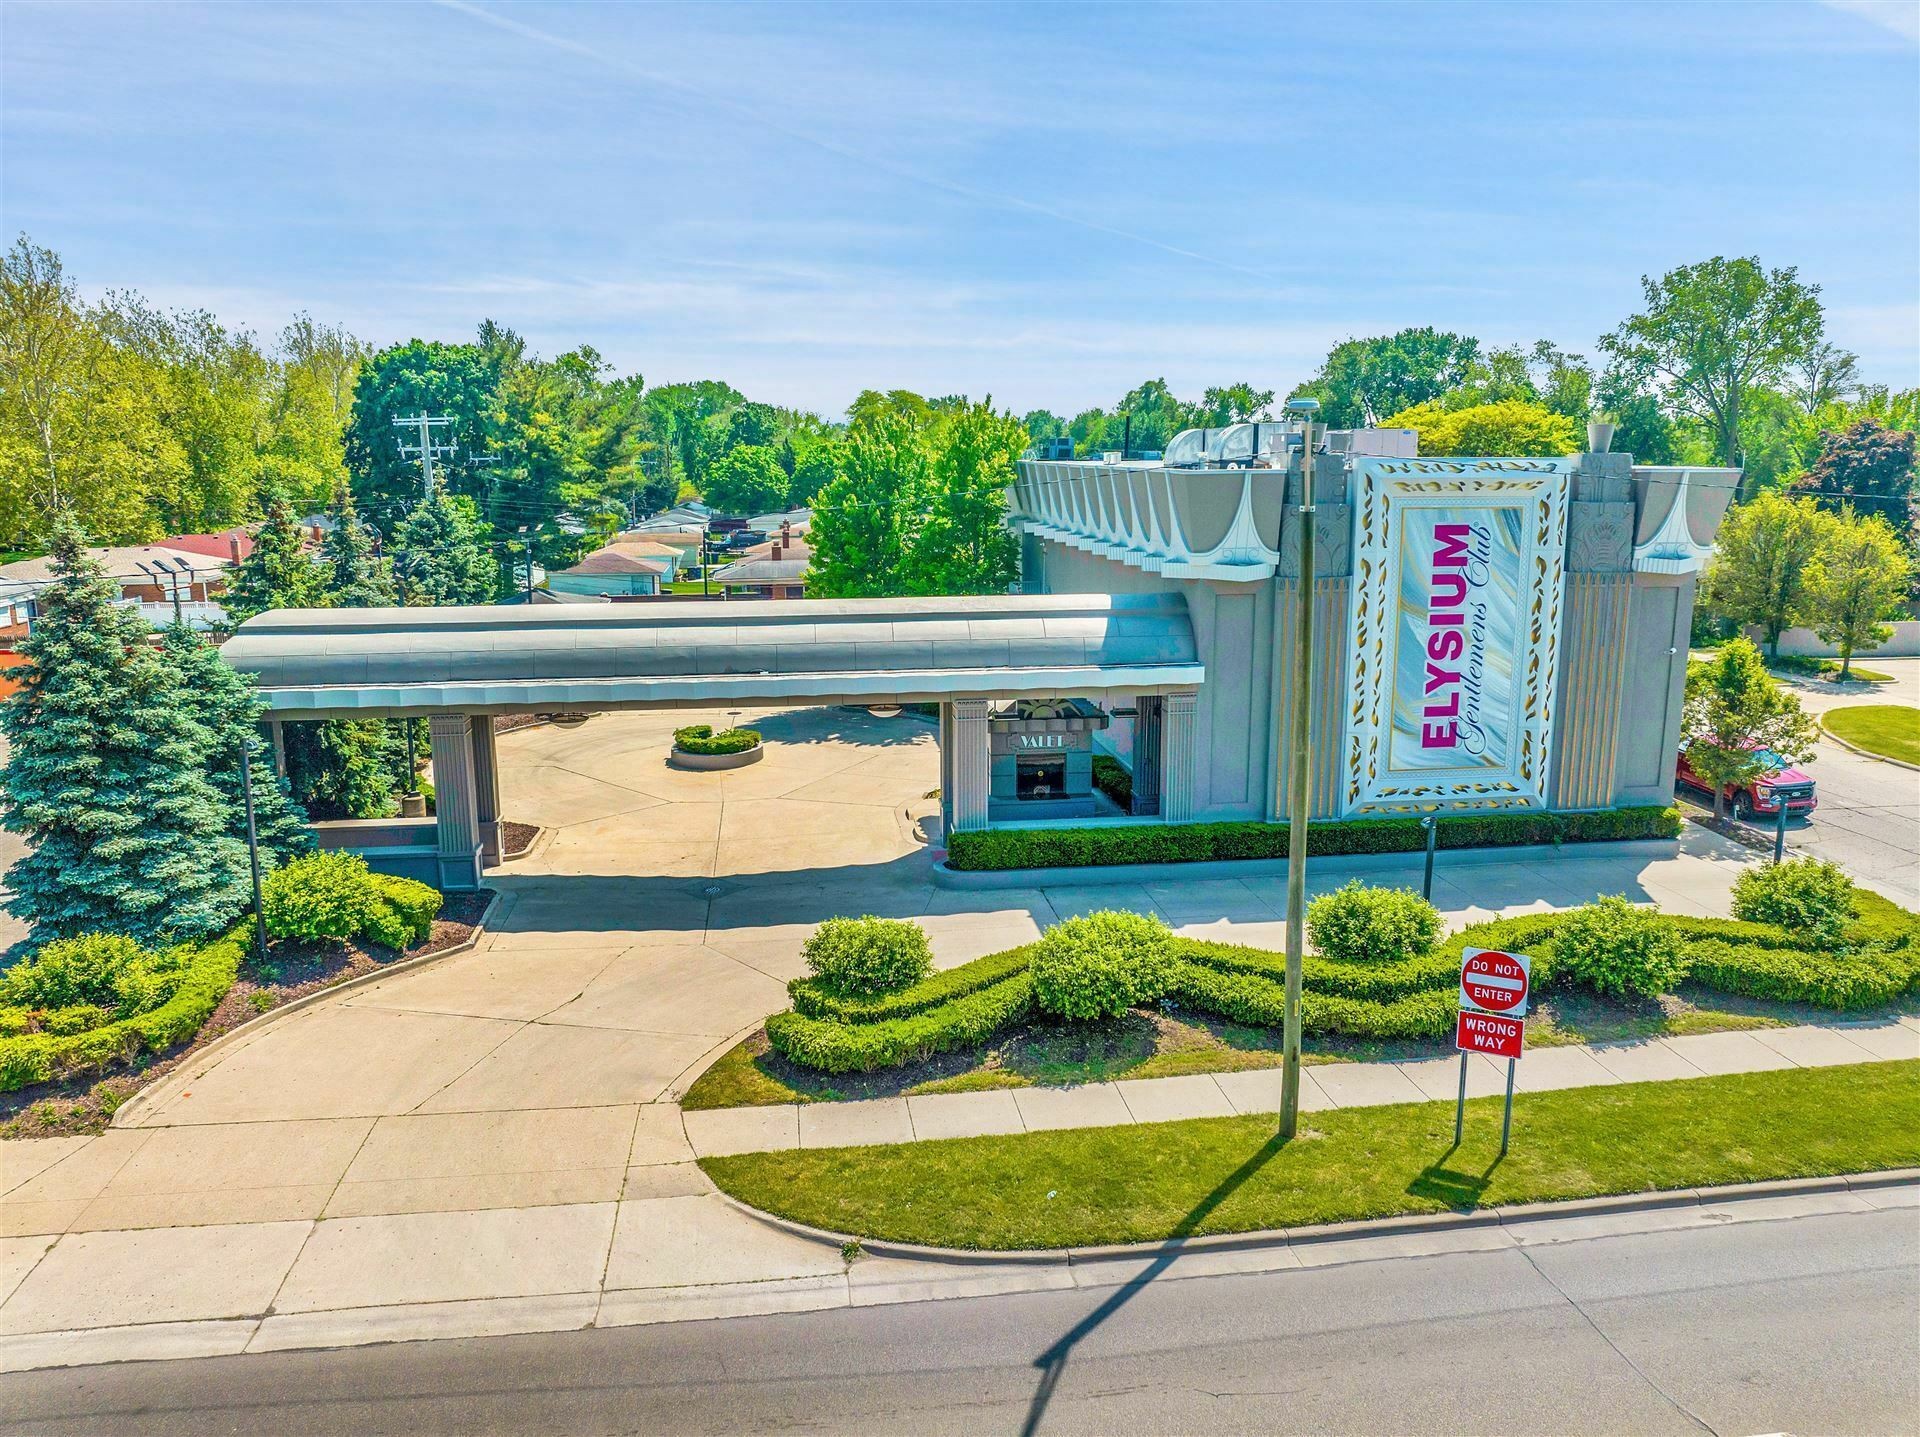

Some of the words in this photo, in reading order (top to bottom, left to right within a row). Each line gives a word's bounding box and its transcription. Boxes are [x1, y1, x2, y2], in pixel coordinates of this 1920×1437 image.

[1422, 524, 1470, 749] ELYSIUM
[1446, 602, 1487, 755] Gentlemens
[1021, 735, 1063, 748] VALET
[1472, 960, 1488, 972] DO
[1495, 963, 1519, 976] NOT
[1474, 987, 1512, 1002] ENTER
[1466, 1018, 1516, 1037] WRONG
[1474, 1034, 1505, 1050] WAY
